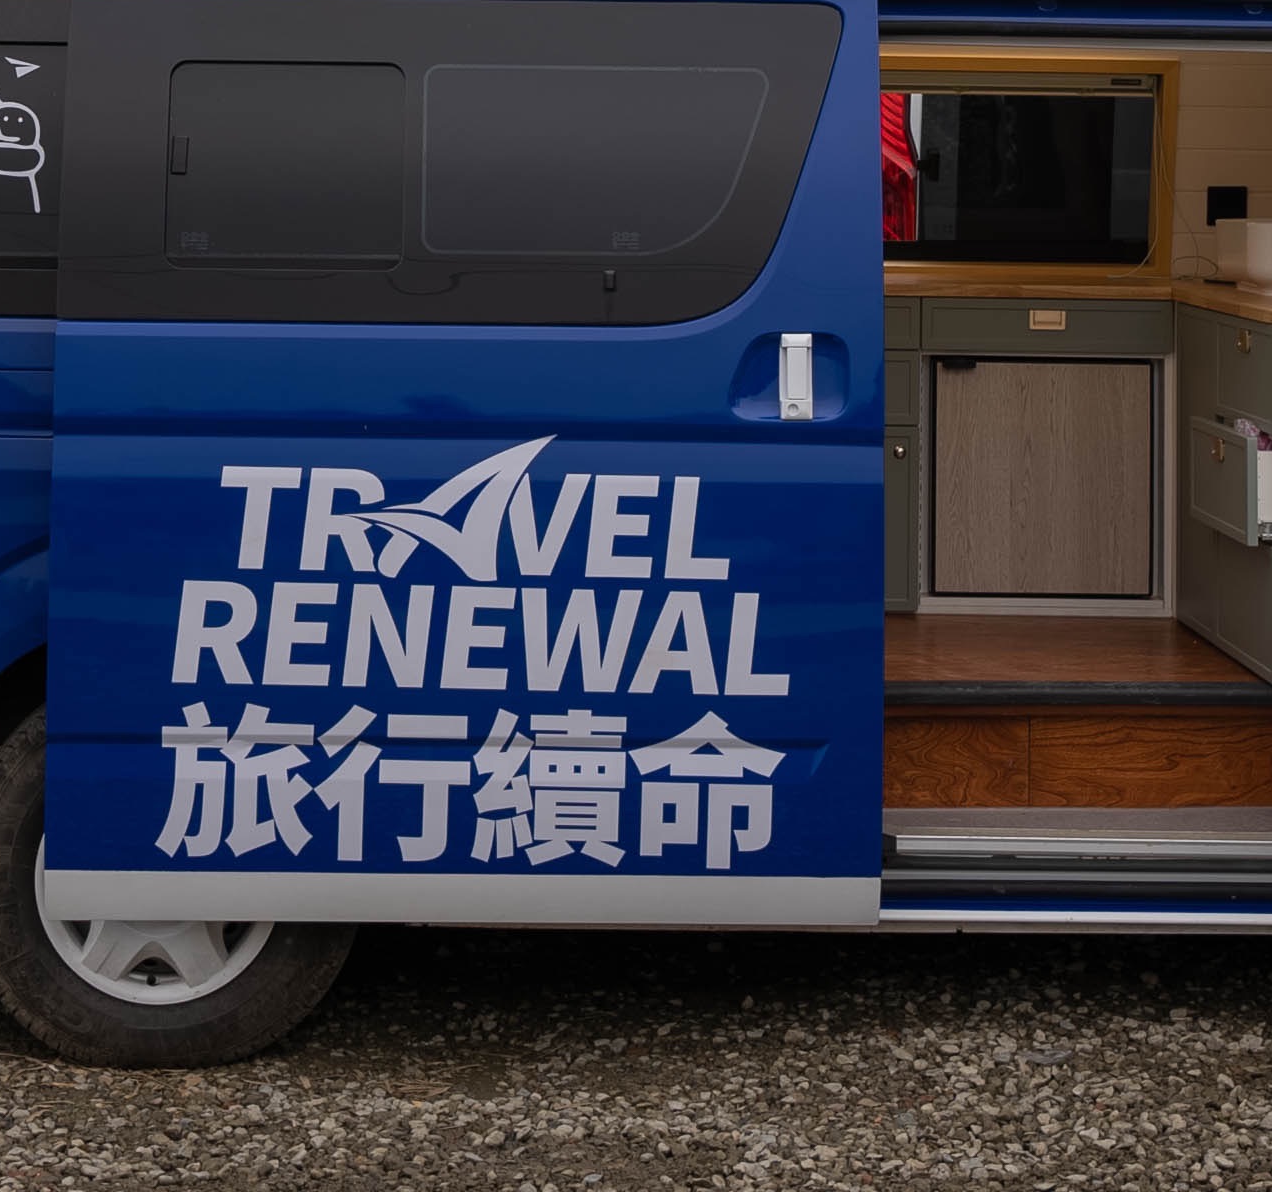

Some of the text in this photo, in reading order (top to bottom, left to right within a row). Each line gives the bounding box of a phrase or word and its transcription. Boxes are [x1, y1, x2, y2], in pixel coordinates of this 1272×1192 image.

[220, 435, 730, 582] TRAVEL
[171, 580, 790, 696] RENEWAL
[154, 701, 786, 869] 旅行續命
